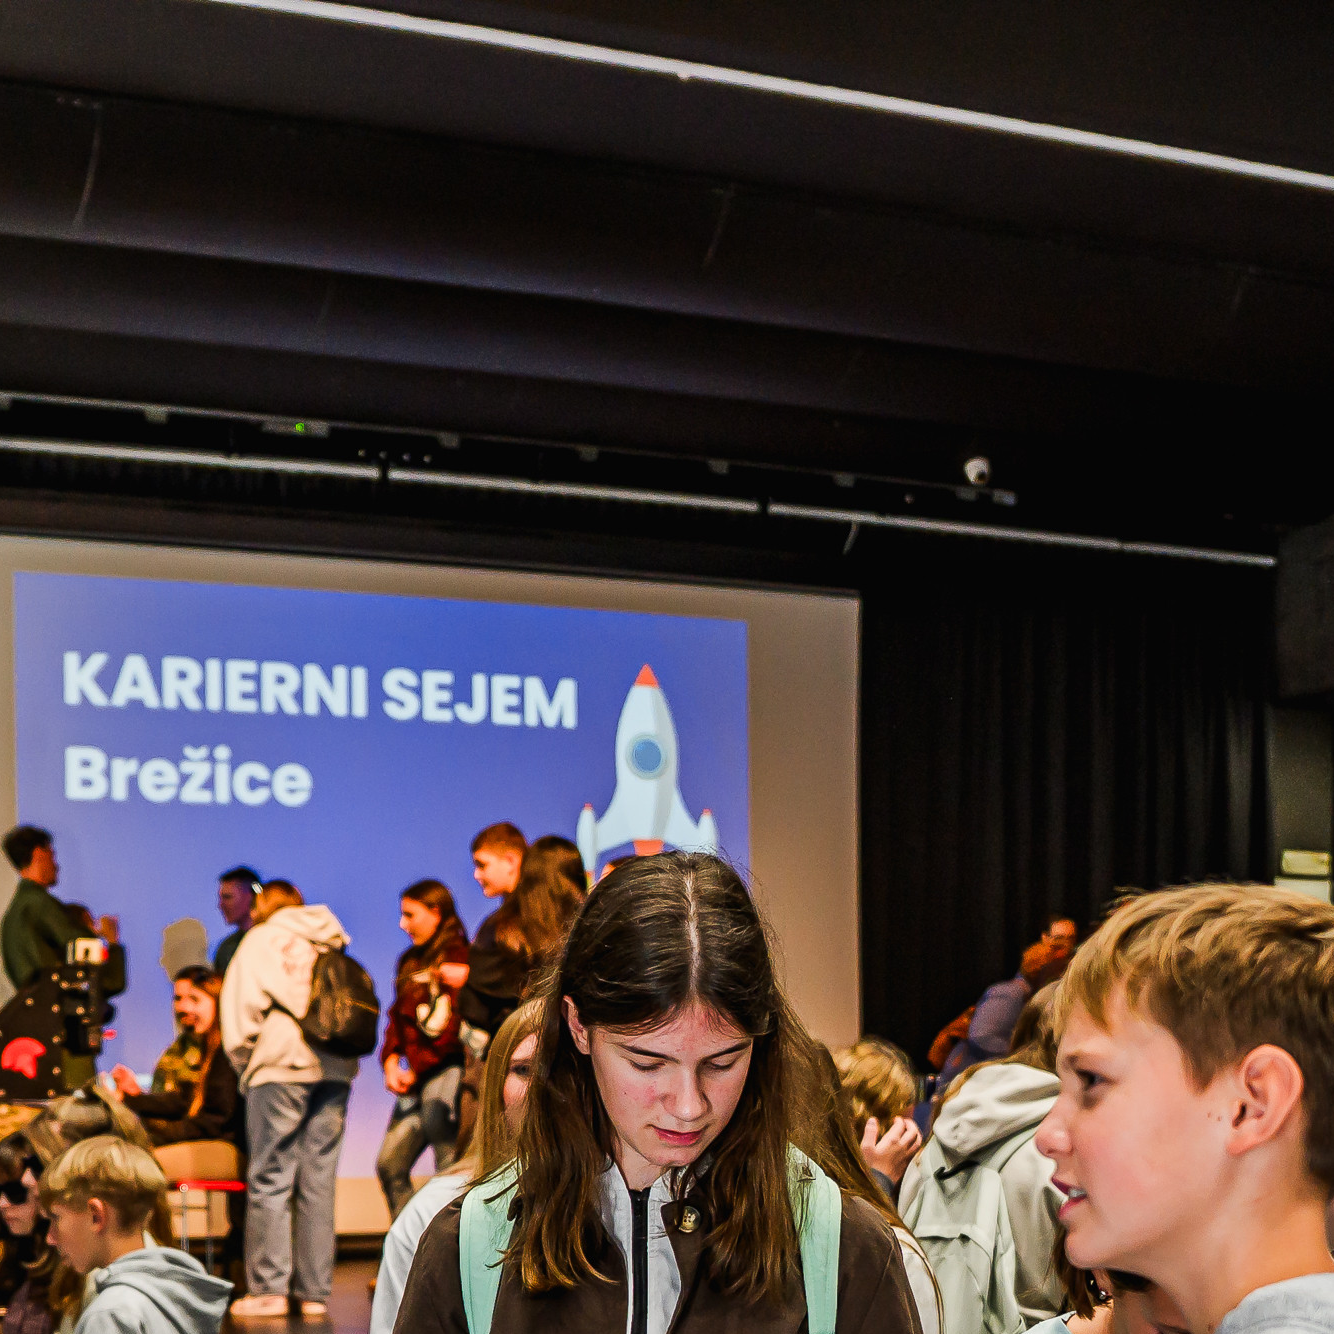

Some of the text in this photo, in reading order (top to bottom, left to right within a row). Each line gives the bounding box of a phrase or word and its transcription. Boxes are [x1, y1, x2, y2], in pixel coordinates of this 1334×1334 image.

[63, 651, 579, 729] KARIERNI SEJEM
[64, 744, 314, 808] Brežice
